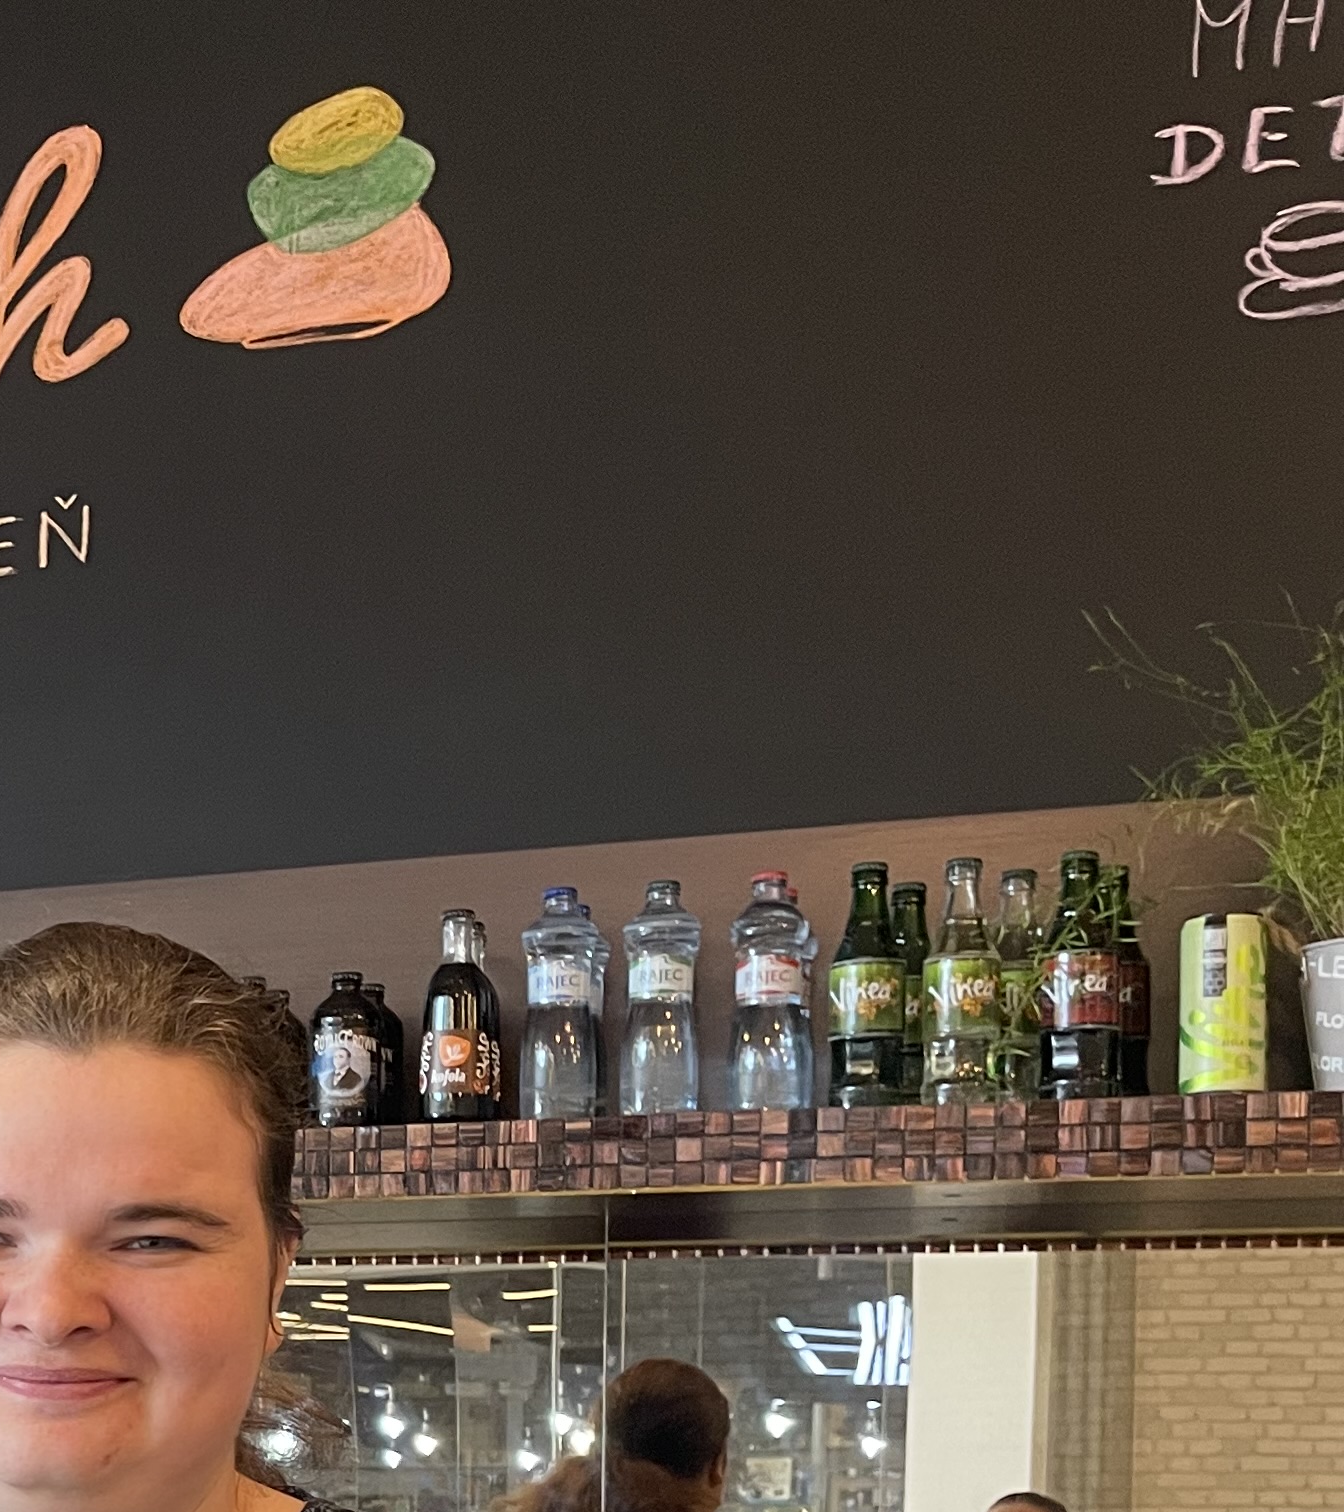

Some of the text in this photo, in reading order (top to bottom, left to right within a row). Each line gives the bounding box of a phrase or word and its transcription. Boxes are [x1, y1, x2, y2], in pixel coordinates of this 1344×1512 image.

[536, 973, 581, 990] RAJEC
[639, 968, 684, 985] RAJEC
[744, 969, 792, 985] RAJEC
[431, 1067, 466, 1087] kofola
